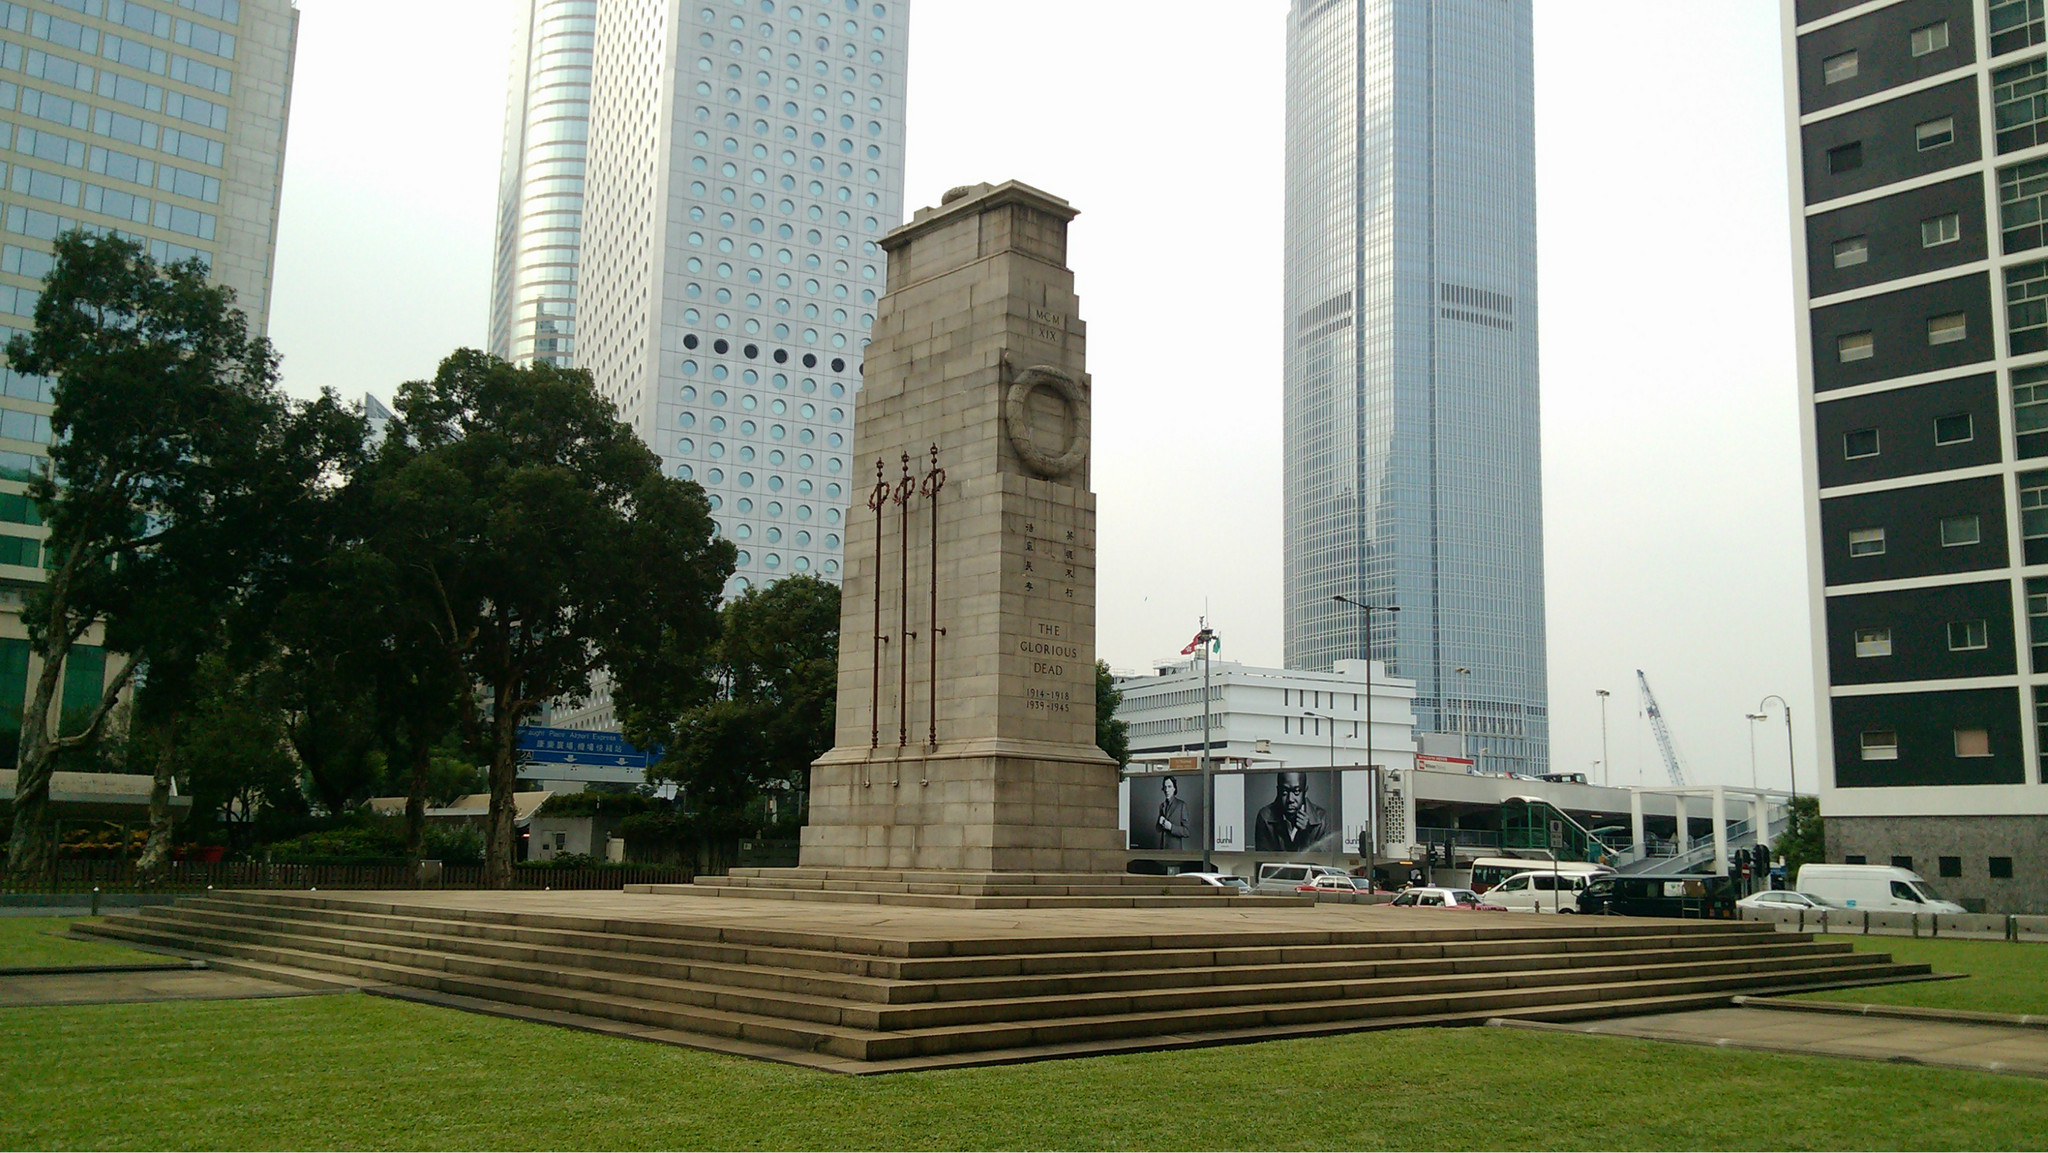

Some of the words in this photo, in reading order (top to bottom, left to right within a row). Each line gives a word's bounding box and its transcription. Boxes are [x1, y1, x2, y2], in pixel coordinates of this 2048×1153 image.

[1039, 328, 1056, 342] XIX
[1038, 623, 1060, 636] THE
[1020, 641, 1077, 658] GLORIOUS
[1034, 662, 1063, 676] DEAD
[570, 732, 590, 740] Airport
[592, 733, 616, 741] Express
